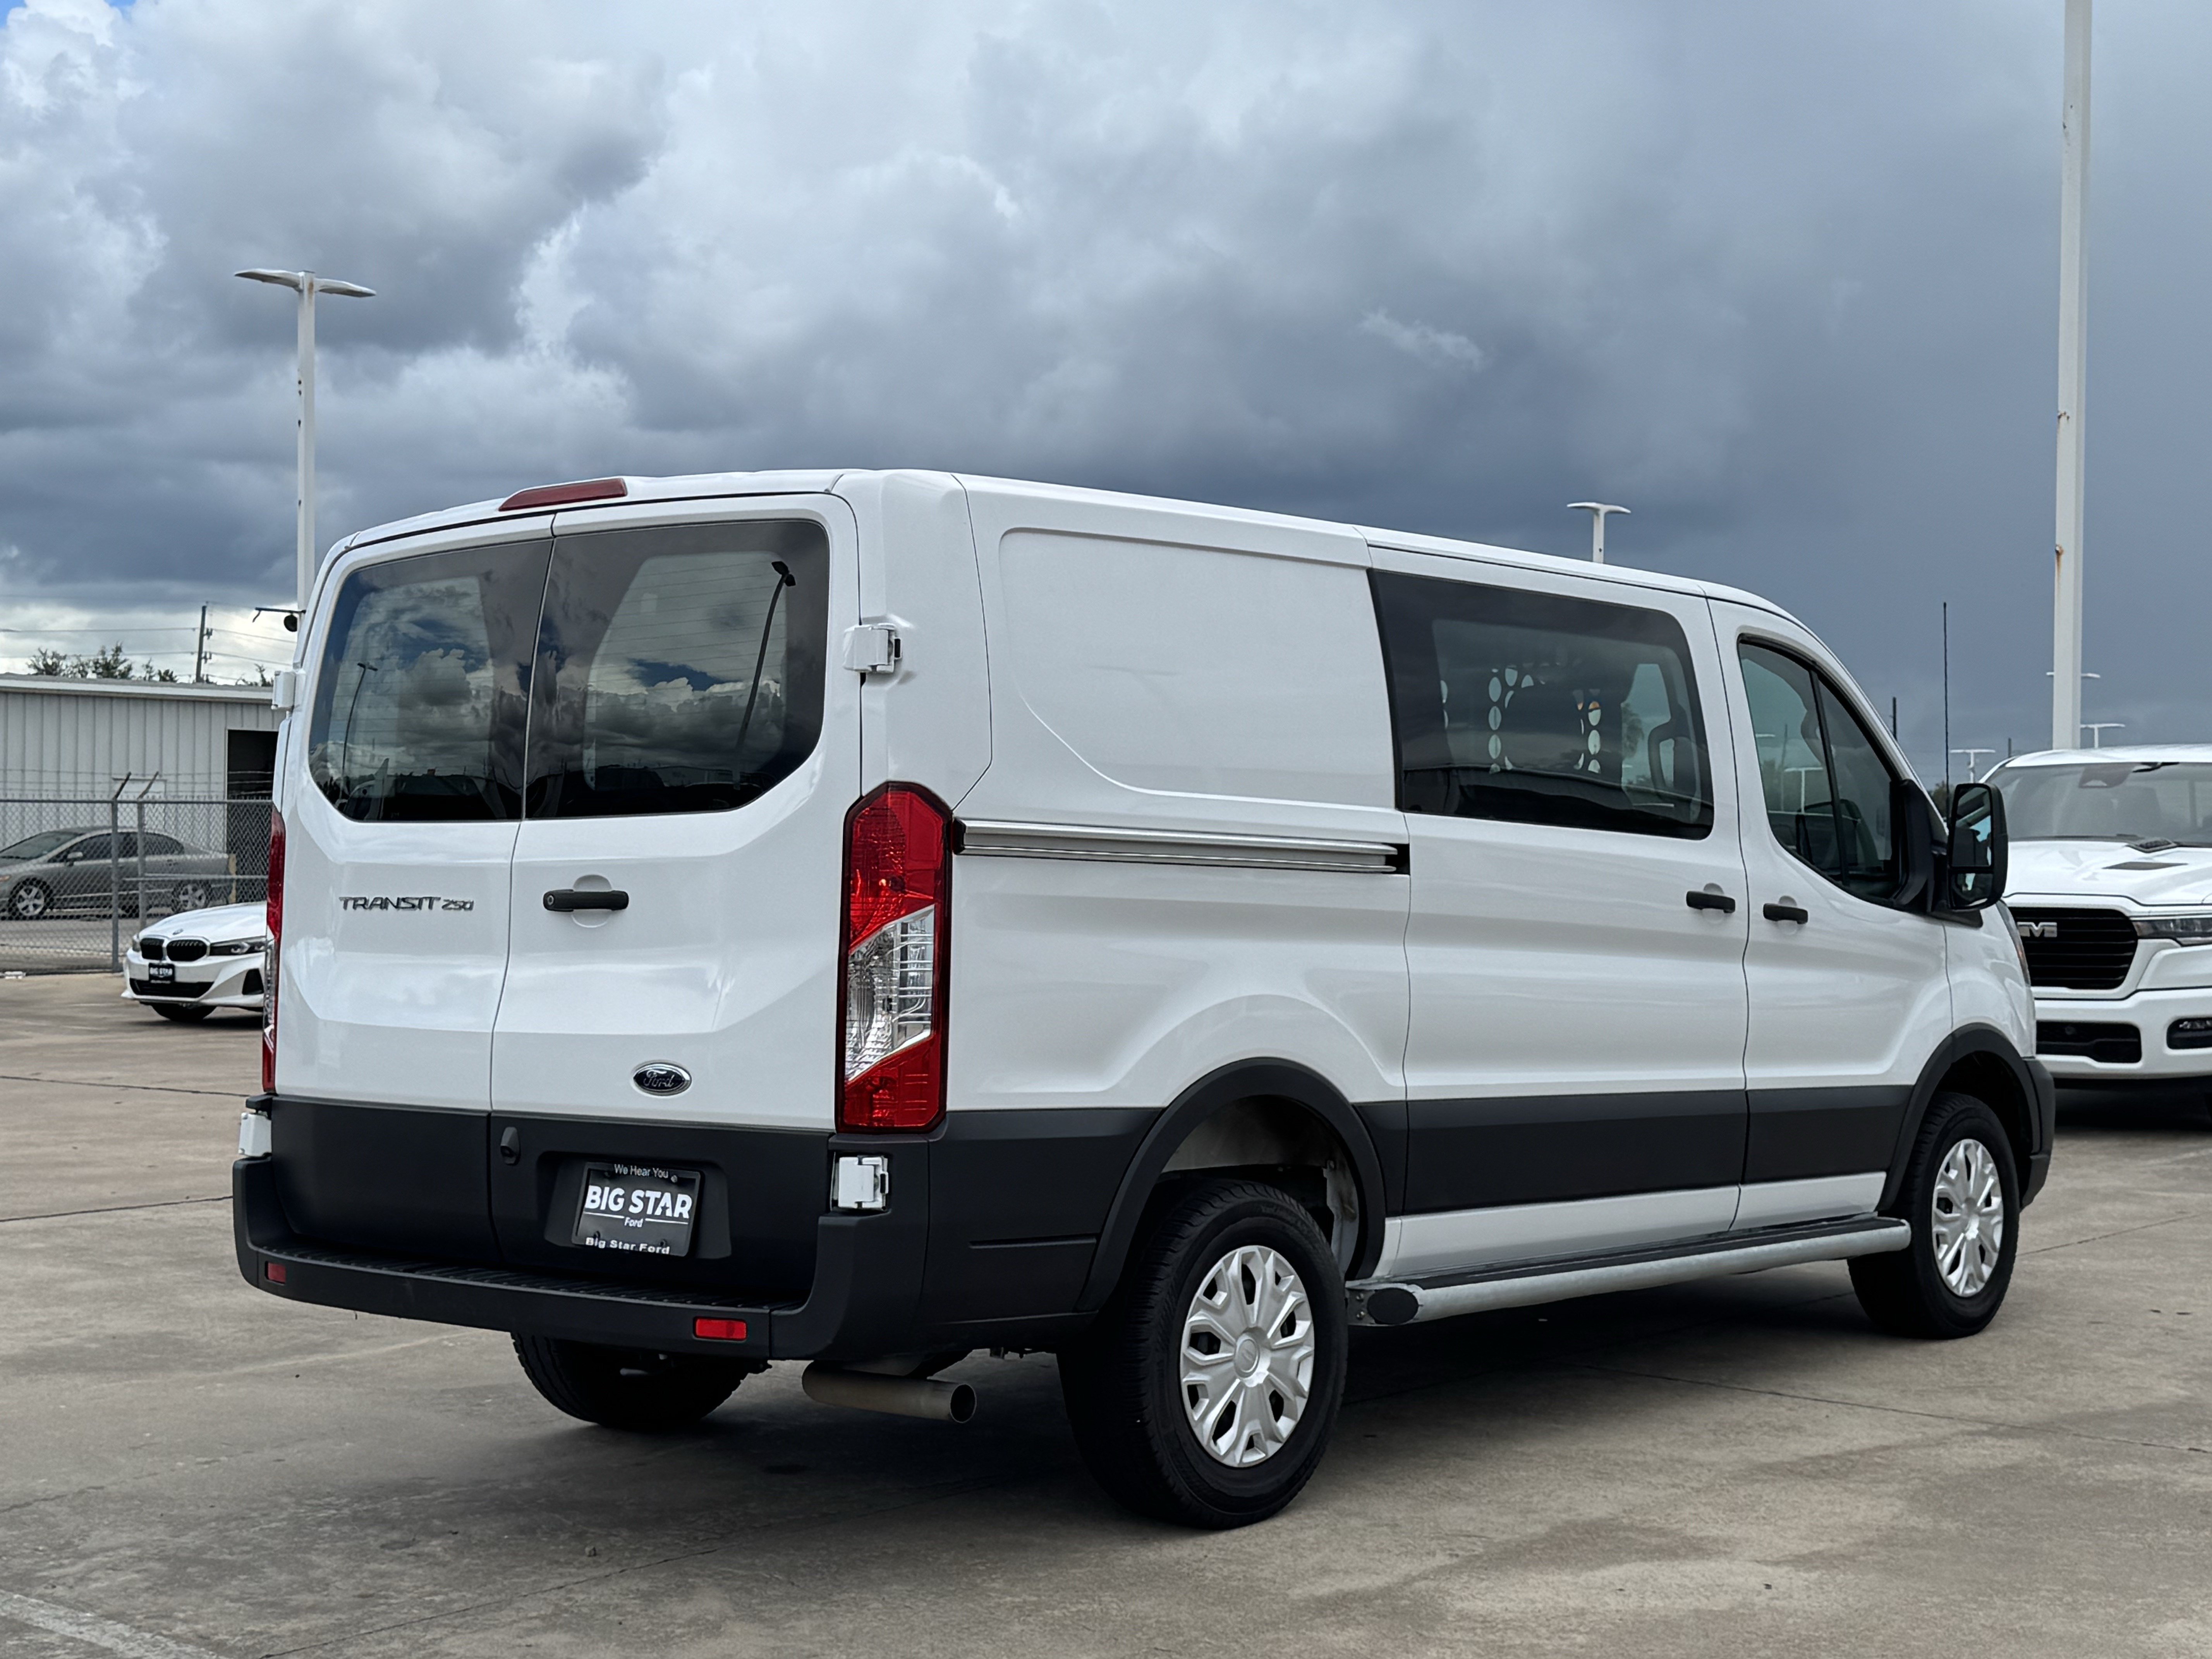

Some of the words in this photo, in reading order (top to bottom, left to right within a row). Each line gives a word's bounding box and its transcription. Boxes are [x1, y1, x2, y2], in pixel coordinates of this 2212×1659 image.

[339, 897, 441, 910] TRANSIT
[442, 899, 474, 910] 250
[643, 1070, 675, 1087] Ford
[614, 1164, 628, 1175] We
[630, 1165, 651, 1176] Hear
[653, 1168, 668, 1178] You
[585, 1185, 625, 1211] BIG
[629, 1190, 692, 1219] STAR
[625, 1217, 644, 1228] Ford
[586, 1237, 606, 1248] Big
[610, 1240, 636, 1250] Star
[639, 1243, 670, 1254] Ford
